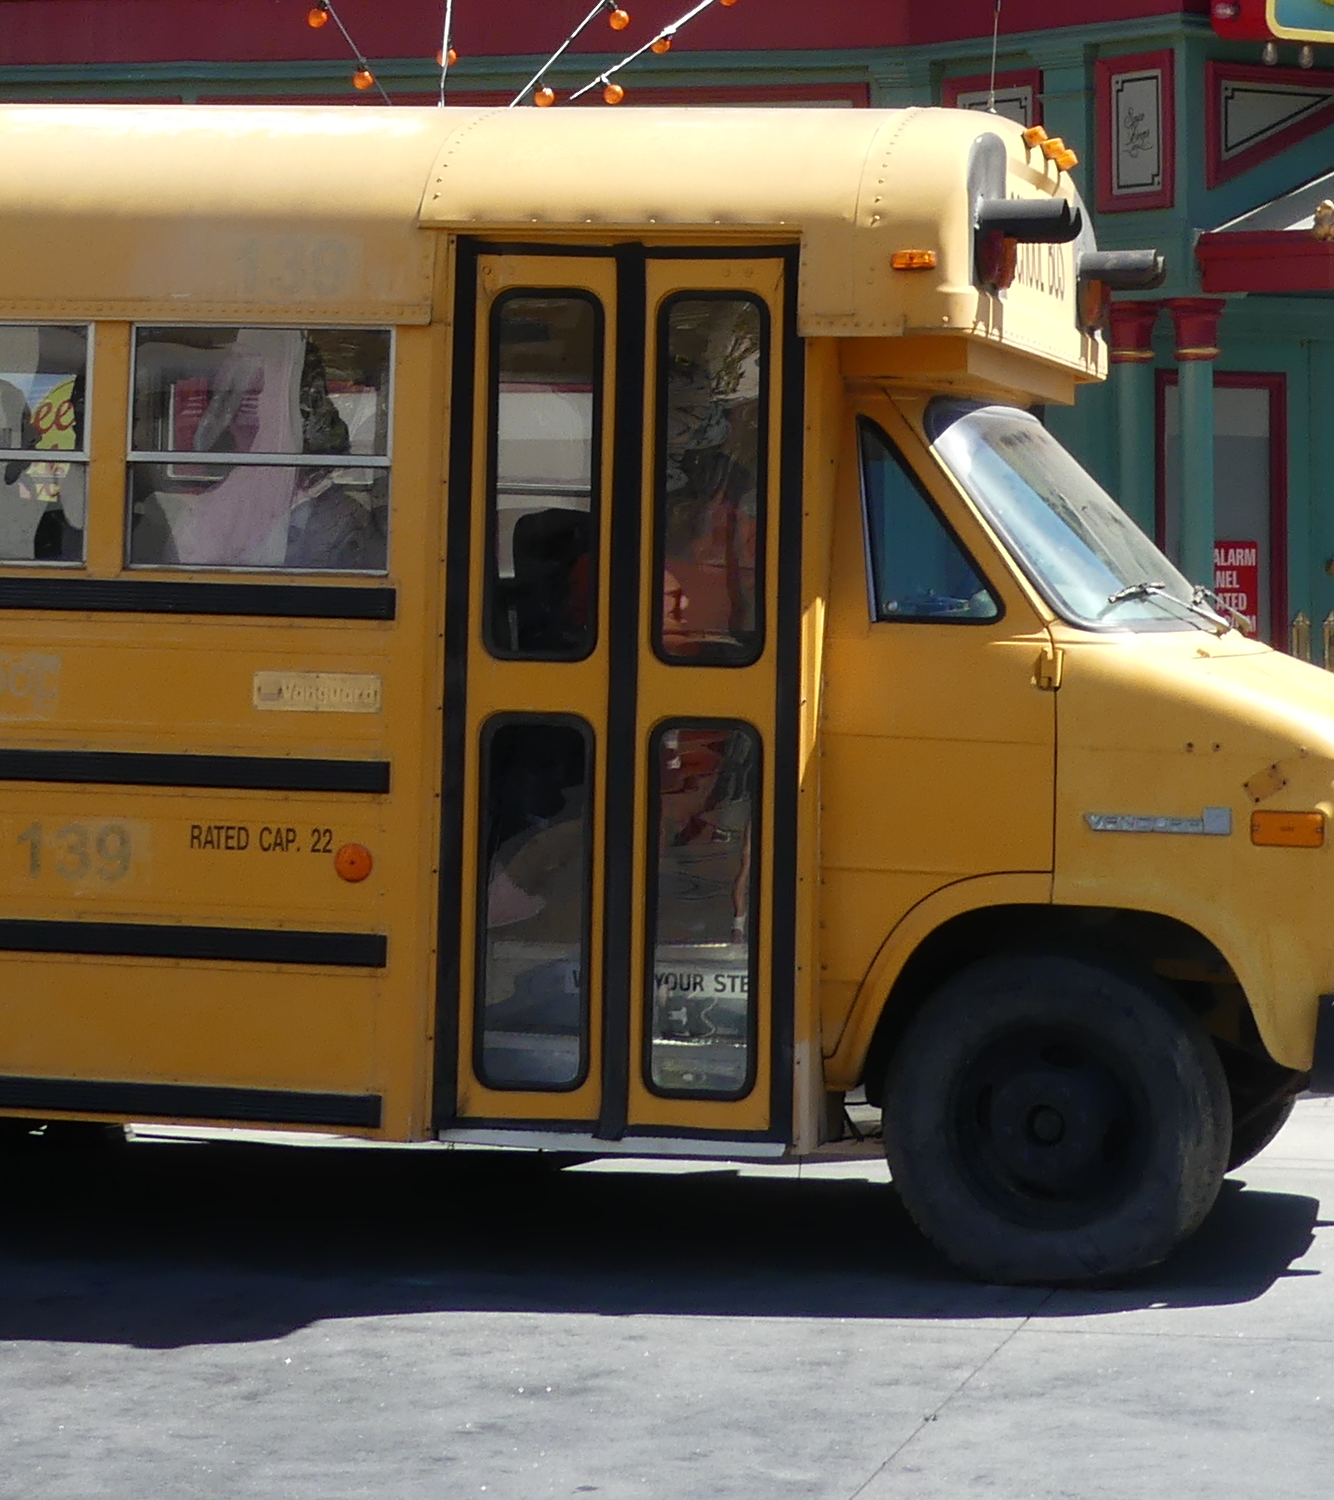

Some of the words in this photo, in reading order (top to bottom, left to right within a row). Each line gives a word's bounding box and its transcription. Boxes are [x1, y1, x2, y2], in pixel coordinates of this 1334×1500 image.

[1214, 548, 1257, 567] ALARM
[1216, 570, 1240, 588] NEL
[283, 681, 379, 703] Vanguard
[190, 824, 250, 851] RATED
[258, 826, 301, 852] CAP.
[310, 828, 334, 853] 22
[17, 820, 133, 883] 139
[654, 973, 704, 993] YOUR
[713, 973, 749, 993] STE
